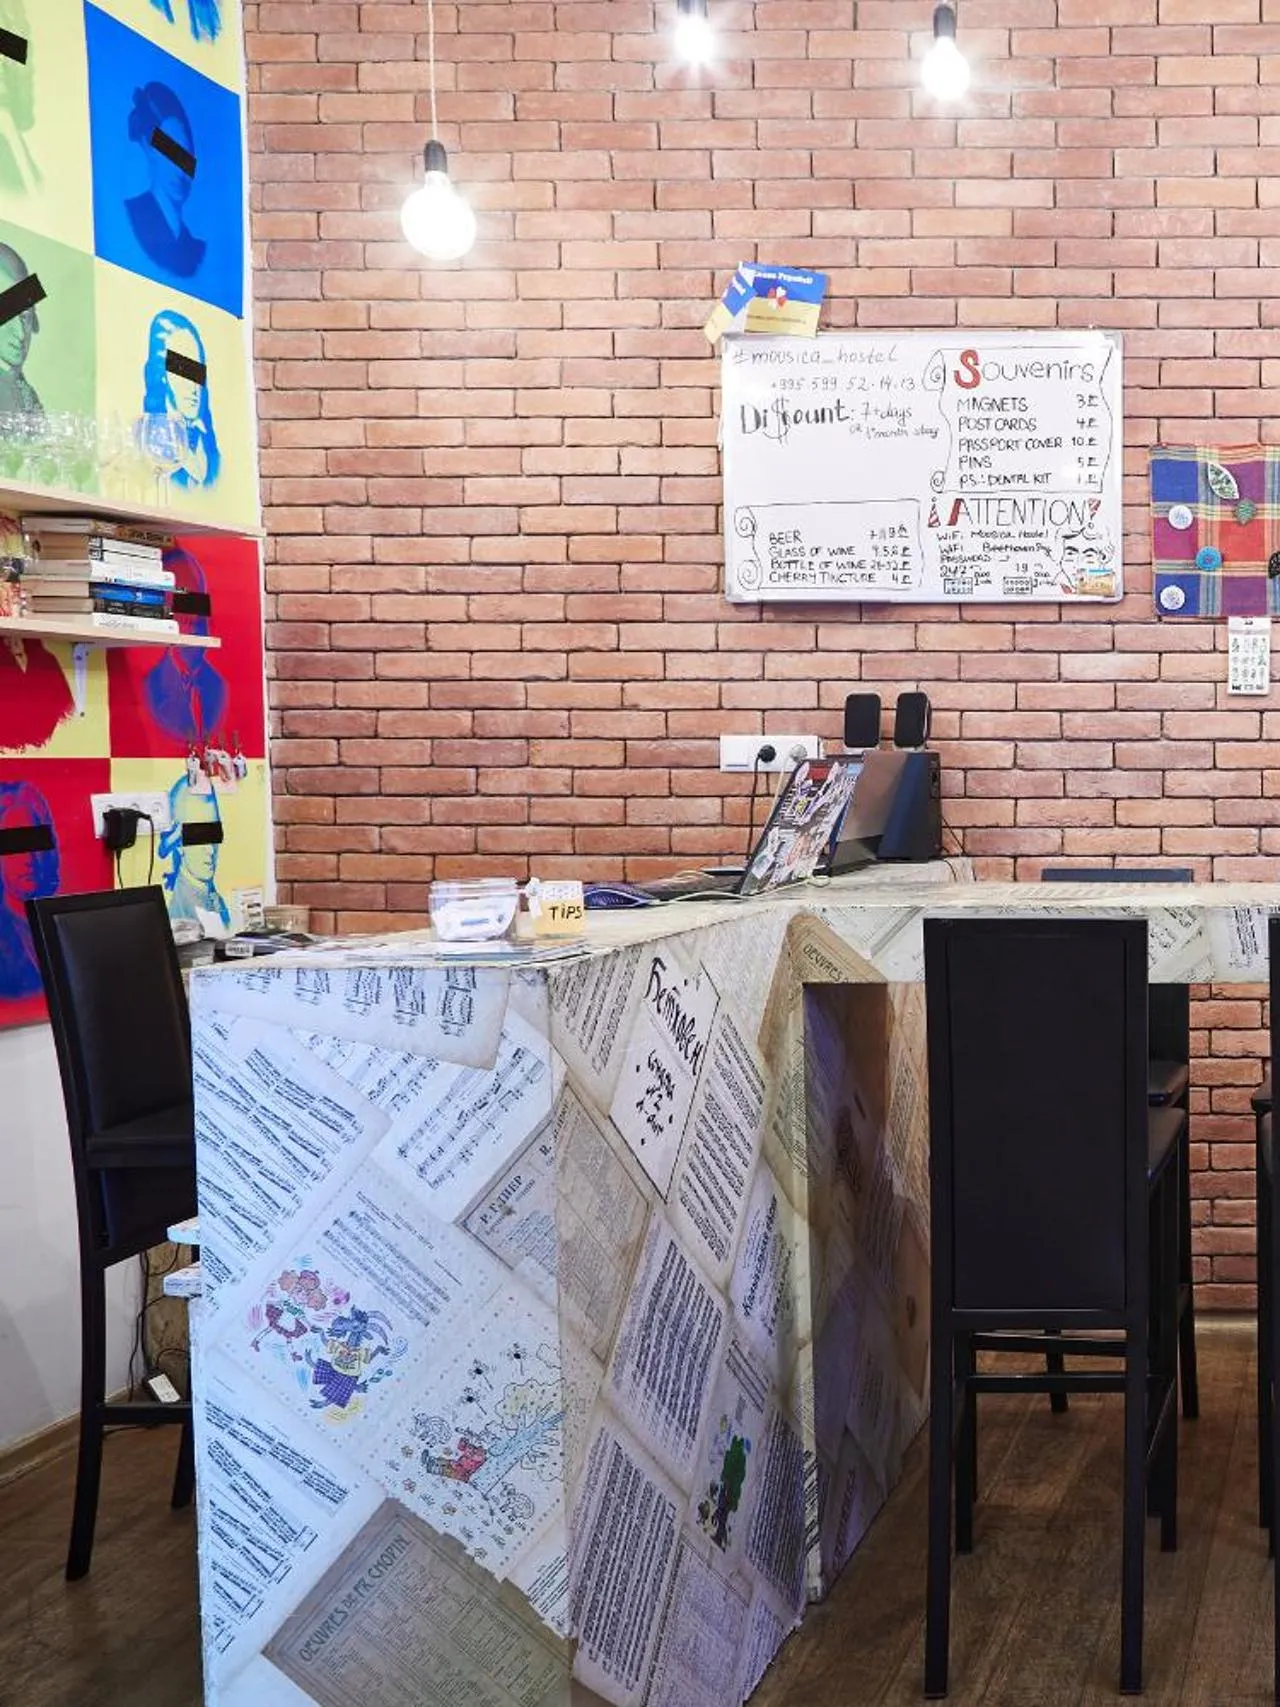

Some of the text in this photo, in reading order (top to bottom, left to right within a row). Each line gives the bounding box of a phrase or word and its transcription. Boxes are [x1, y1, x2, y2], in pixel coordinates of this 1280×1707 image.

[954, 349, 1095, 389] Souvenirs
[957, 397, 1028, 412] MAGNETS
[958, 438, 1023, 453] PASSPORT
[1025, 437, 1062, 451] COVER
[958, 456, 992, 470] PINS
[769, 529, 803, 545] BEER
[769, 546, 806, 558] GLASS
[828, 546, 856, 557] WINE
[770, 559, 815, 570] BOTTLE
[818, 560, 832, 570] OF
[836, 560, 866, 570] WINE
[769, 572, 817, 584] CHERRY
